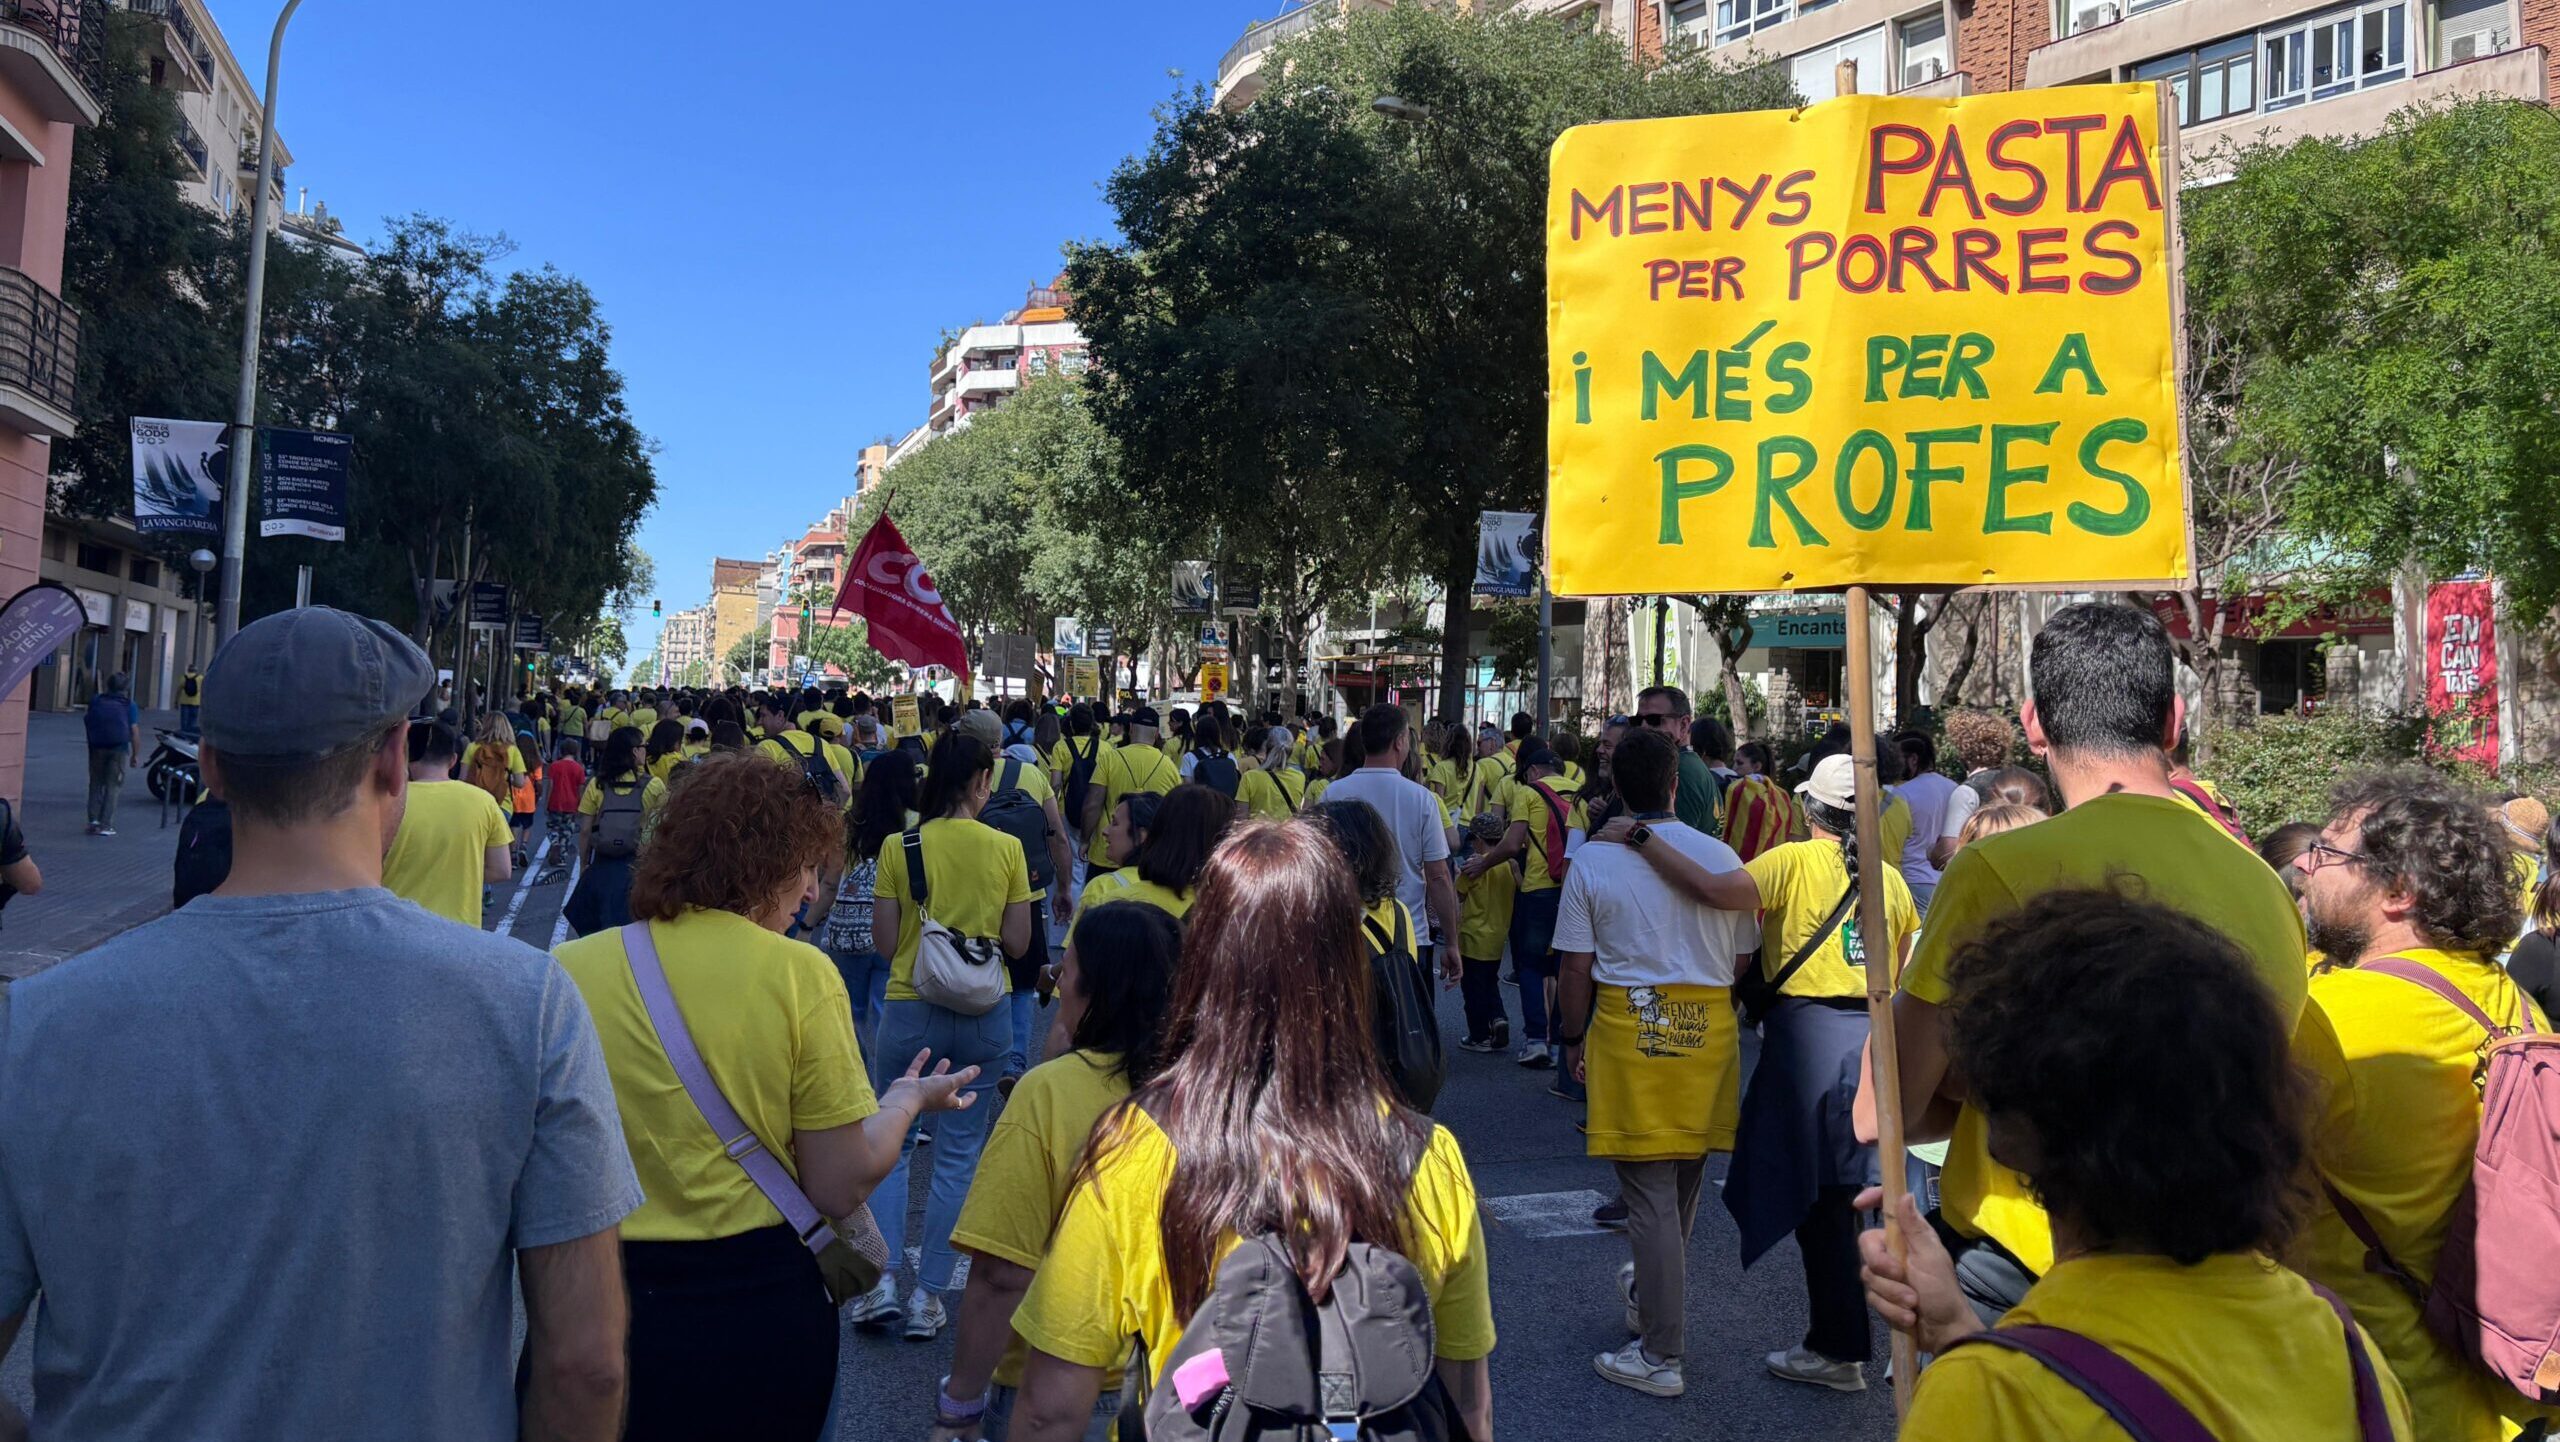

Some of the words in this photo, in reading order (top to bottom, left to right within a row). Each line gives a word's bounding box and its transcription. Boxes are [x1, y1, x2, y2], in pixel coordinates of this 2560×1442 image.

[1571, 170, 1816, 240] MENYS
[1863, 114, 2164, 220] PASTA
[1643, 256, 1745, 301] PER
[1785, 219, 2143, 300] PORRES
[1640, 319, 1813, 422] MÉS
[1864, 332, 1995, 402] PER
[2034, 332, 2108, 396] A
[1654, 417, 2151, 549] PROFES
[15, 622, 55, 654] TENIS
[1778, 618, 1846, 636] Encants
[2442, 614, 2481, 645] EN
[2441, 643, 2480, 670] CAN
